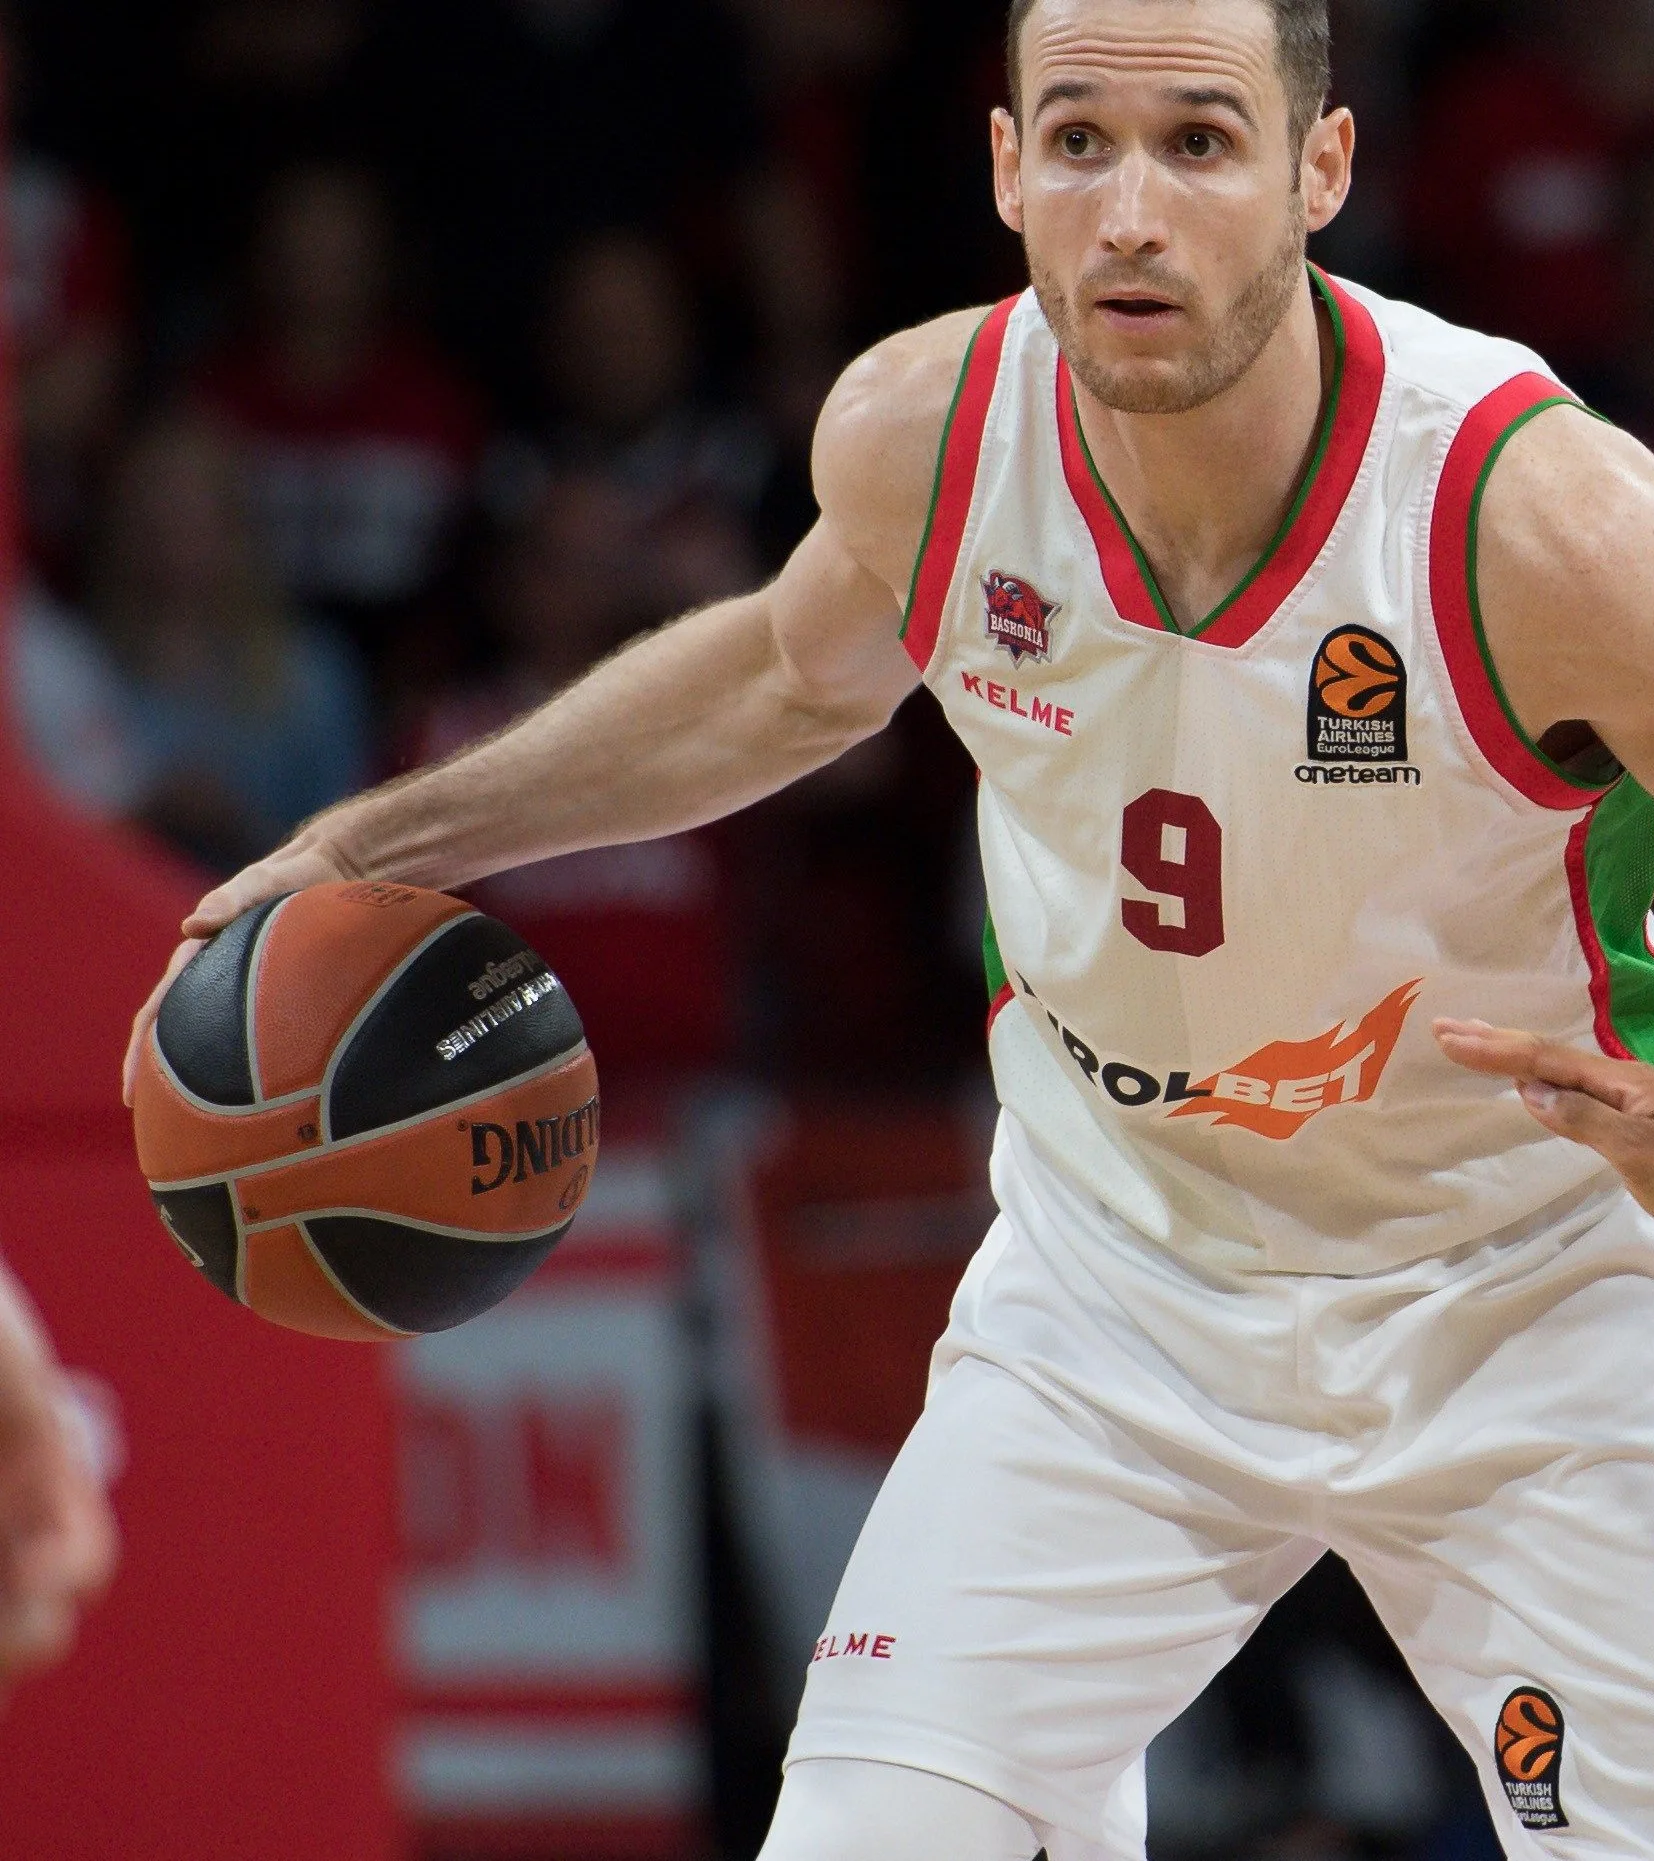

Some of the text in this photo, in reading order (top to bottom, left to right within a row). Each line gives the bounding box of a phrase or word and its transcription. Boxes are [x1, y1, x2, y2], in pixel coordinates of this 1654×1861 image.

[961, 670, 1075, 737] KELME
[1316, 716, 1395, 732] TURKISH
[1316, 730, 1396, 744] AIRLINES
[1316, 742, 1396, 757] EuroLeague
[1293, 764, 1421, 786] oneteam
[1120, 787, 1225, 958] 9
[1015, 970, 1377, 1113] ROLBET
[812, 1632, 897, 1662] ELME
[1505, 1781, 1553, 1797] TURKISH
